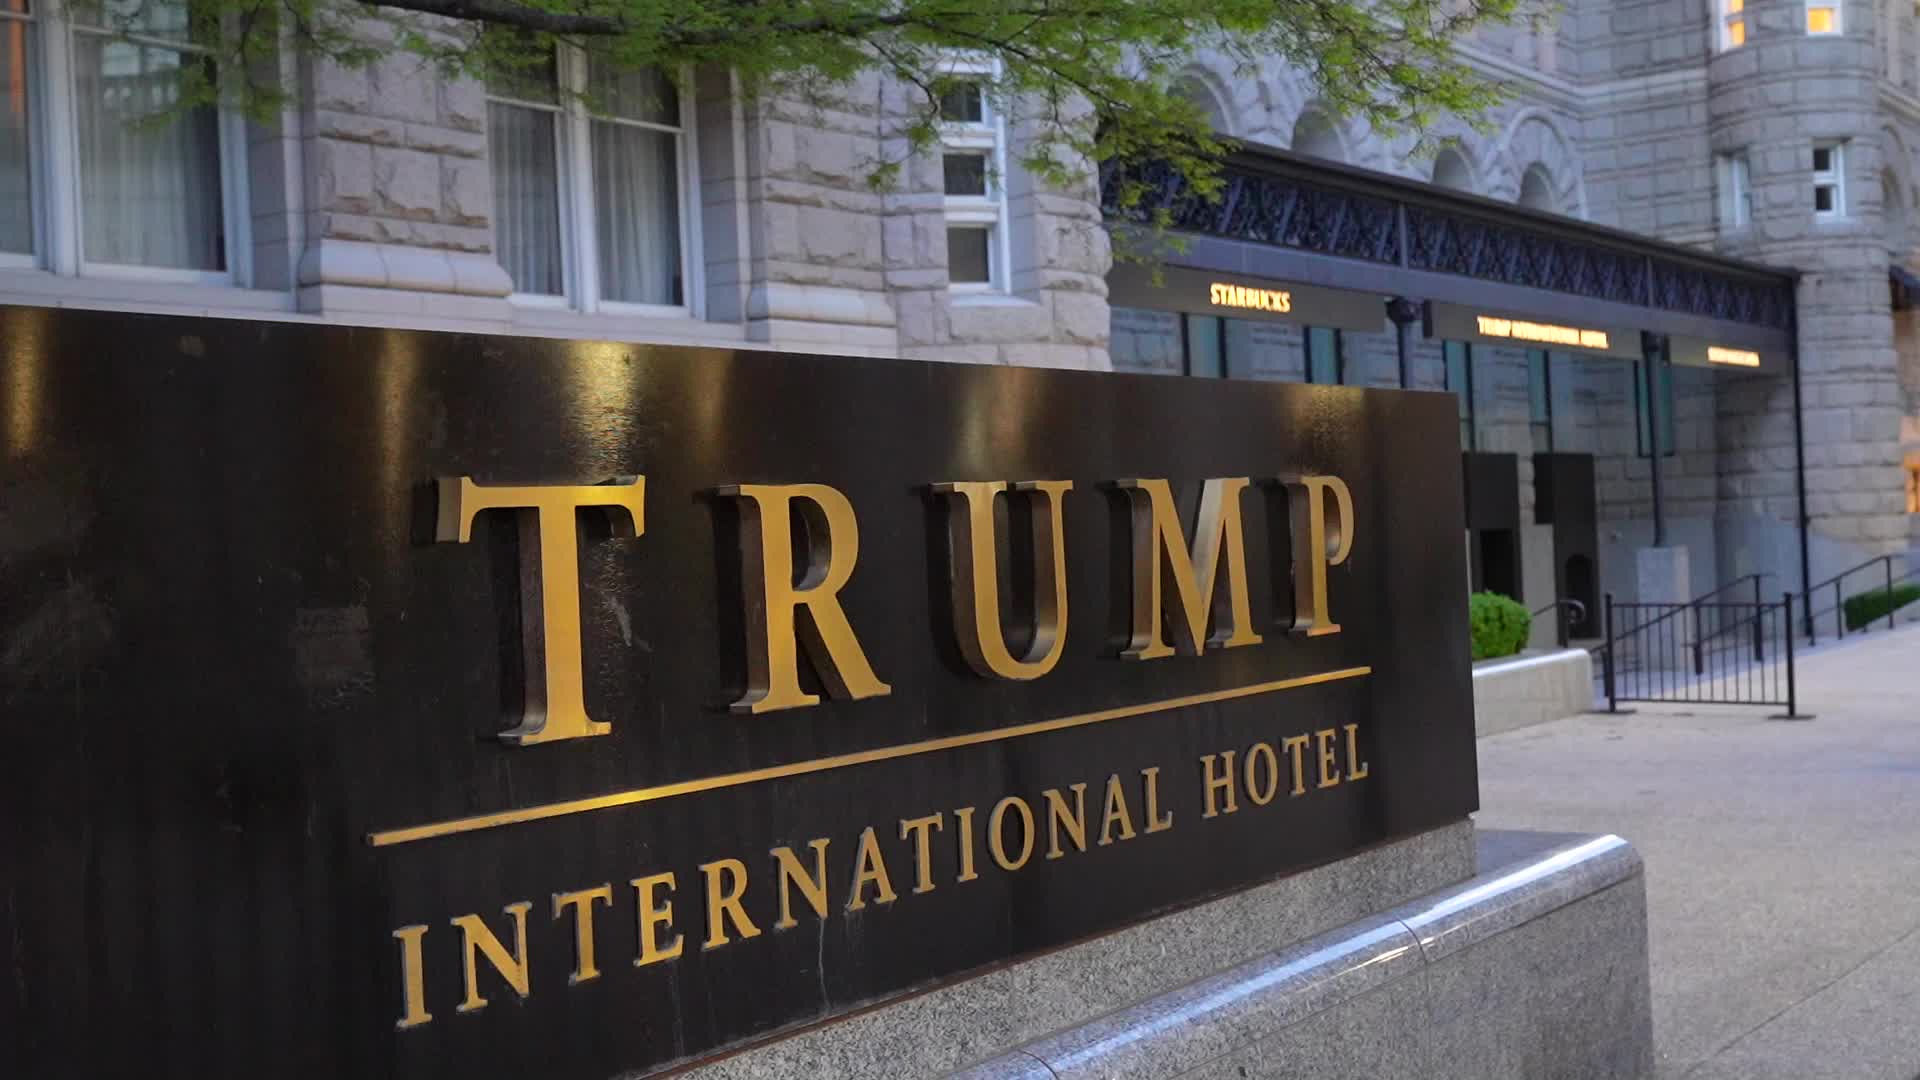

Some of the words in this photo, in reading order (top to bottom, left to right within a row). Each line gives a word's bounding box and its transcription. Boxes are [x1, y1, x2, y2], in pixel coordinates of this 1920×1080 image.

[1210, 282, 1291, 313] STARBUCKS
[438, 474, 1355, 746] TRUMP
[392, 766, 1173, 1030] INTERNATIONAL
[1200, 722, 1369, 819] HOTEL
